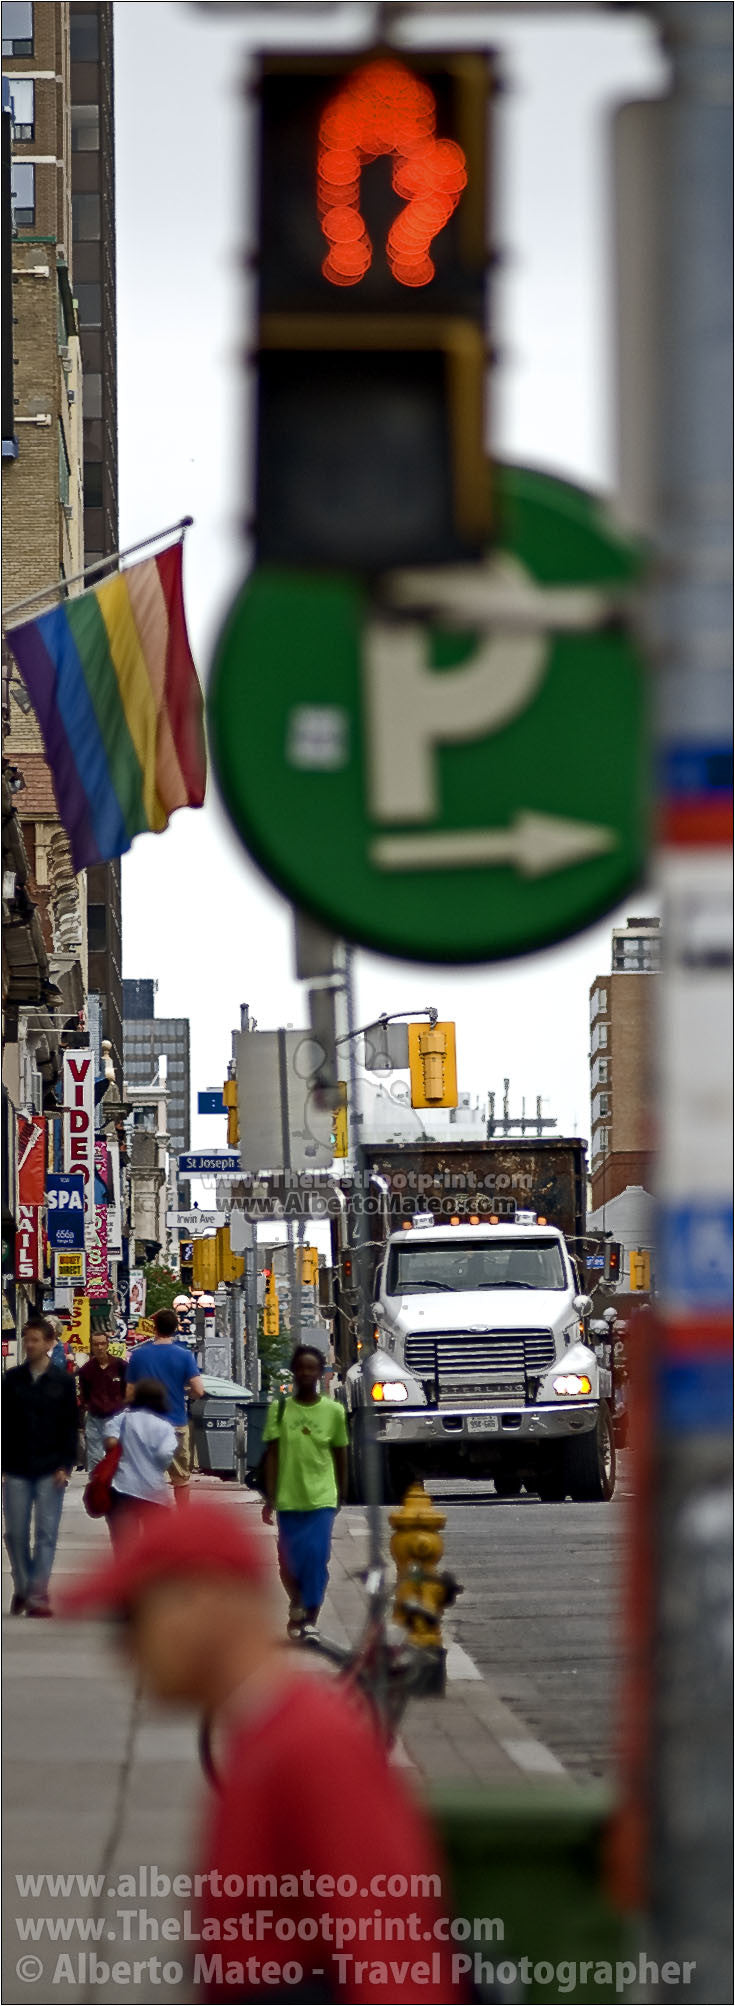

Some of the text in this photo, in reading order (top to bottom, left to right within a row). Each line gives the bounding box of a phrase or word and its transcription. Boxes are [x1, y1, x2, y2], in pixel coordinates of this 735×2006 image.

[364, 552, 550, 821] P
[67, 1059, 91, 1213] VIDEO
[186, 1157, 197, 1169] St
[199, 1157, 235, 1171] Joseph
[48, 1190, 83, 1210] SPA
[176, 1214, 216, 1224] Irwin Ave
[17, 1205, 35, 1278] NAILS
[440, 1385, 524, 1394] STERLING
